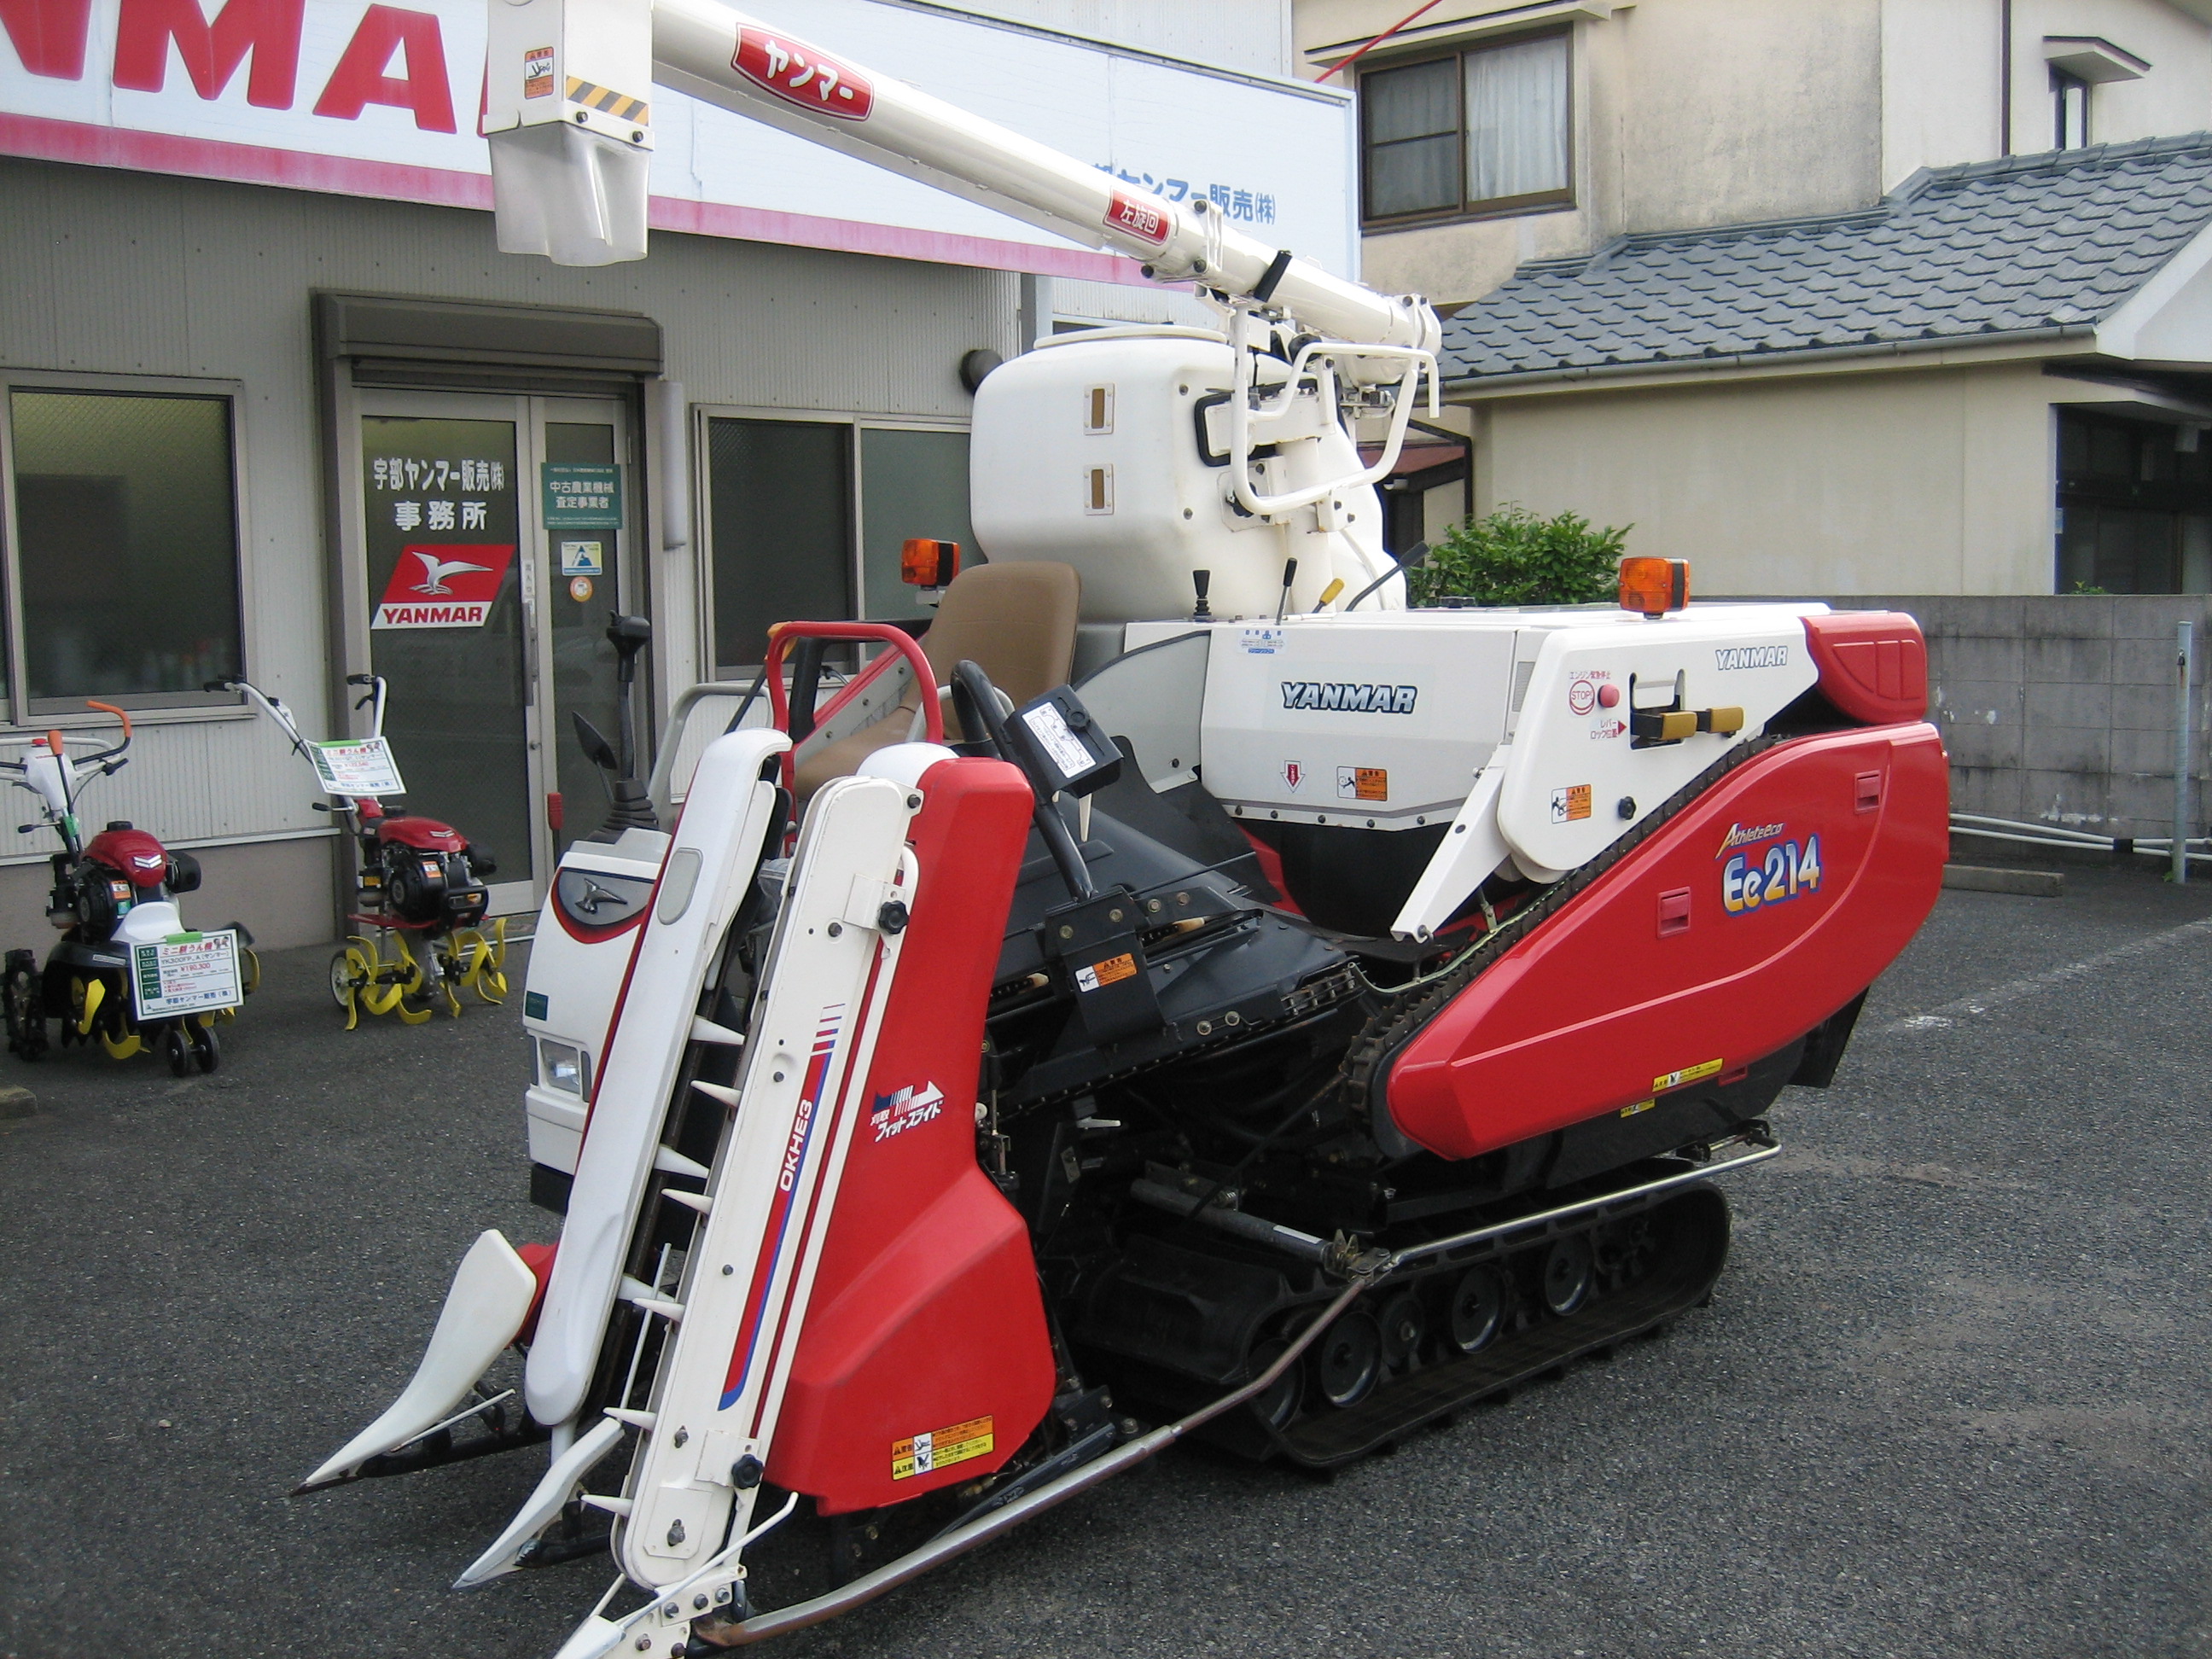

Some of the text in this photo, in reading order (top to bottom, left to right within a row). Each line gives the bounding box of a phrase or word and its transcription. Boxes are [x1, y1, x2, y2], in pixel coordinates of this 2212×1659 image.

[0, 0, 488, 137] MA
[765, 40, 853, 101] ヤンマー
[1120, 200, 1160, 235] 左旋回
[394, 500, 487, 531] 事務所
[556, 497, 609, 509] 査定事業者
[382, 606, 483, 625] YANMAR
[1715, 646, 1787, 670] YANMAR
[1281, 682, 1417, 714] YANMAR
[1722, 834, 1823, 915] Ee214
[780, 1099, 812, 1192] OKHE3
